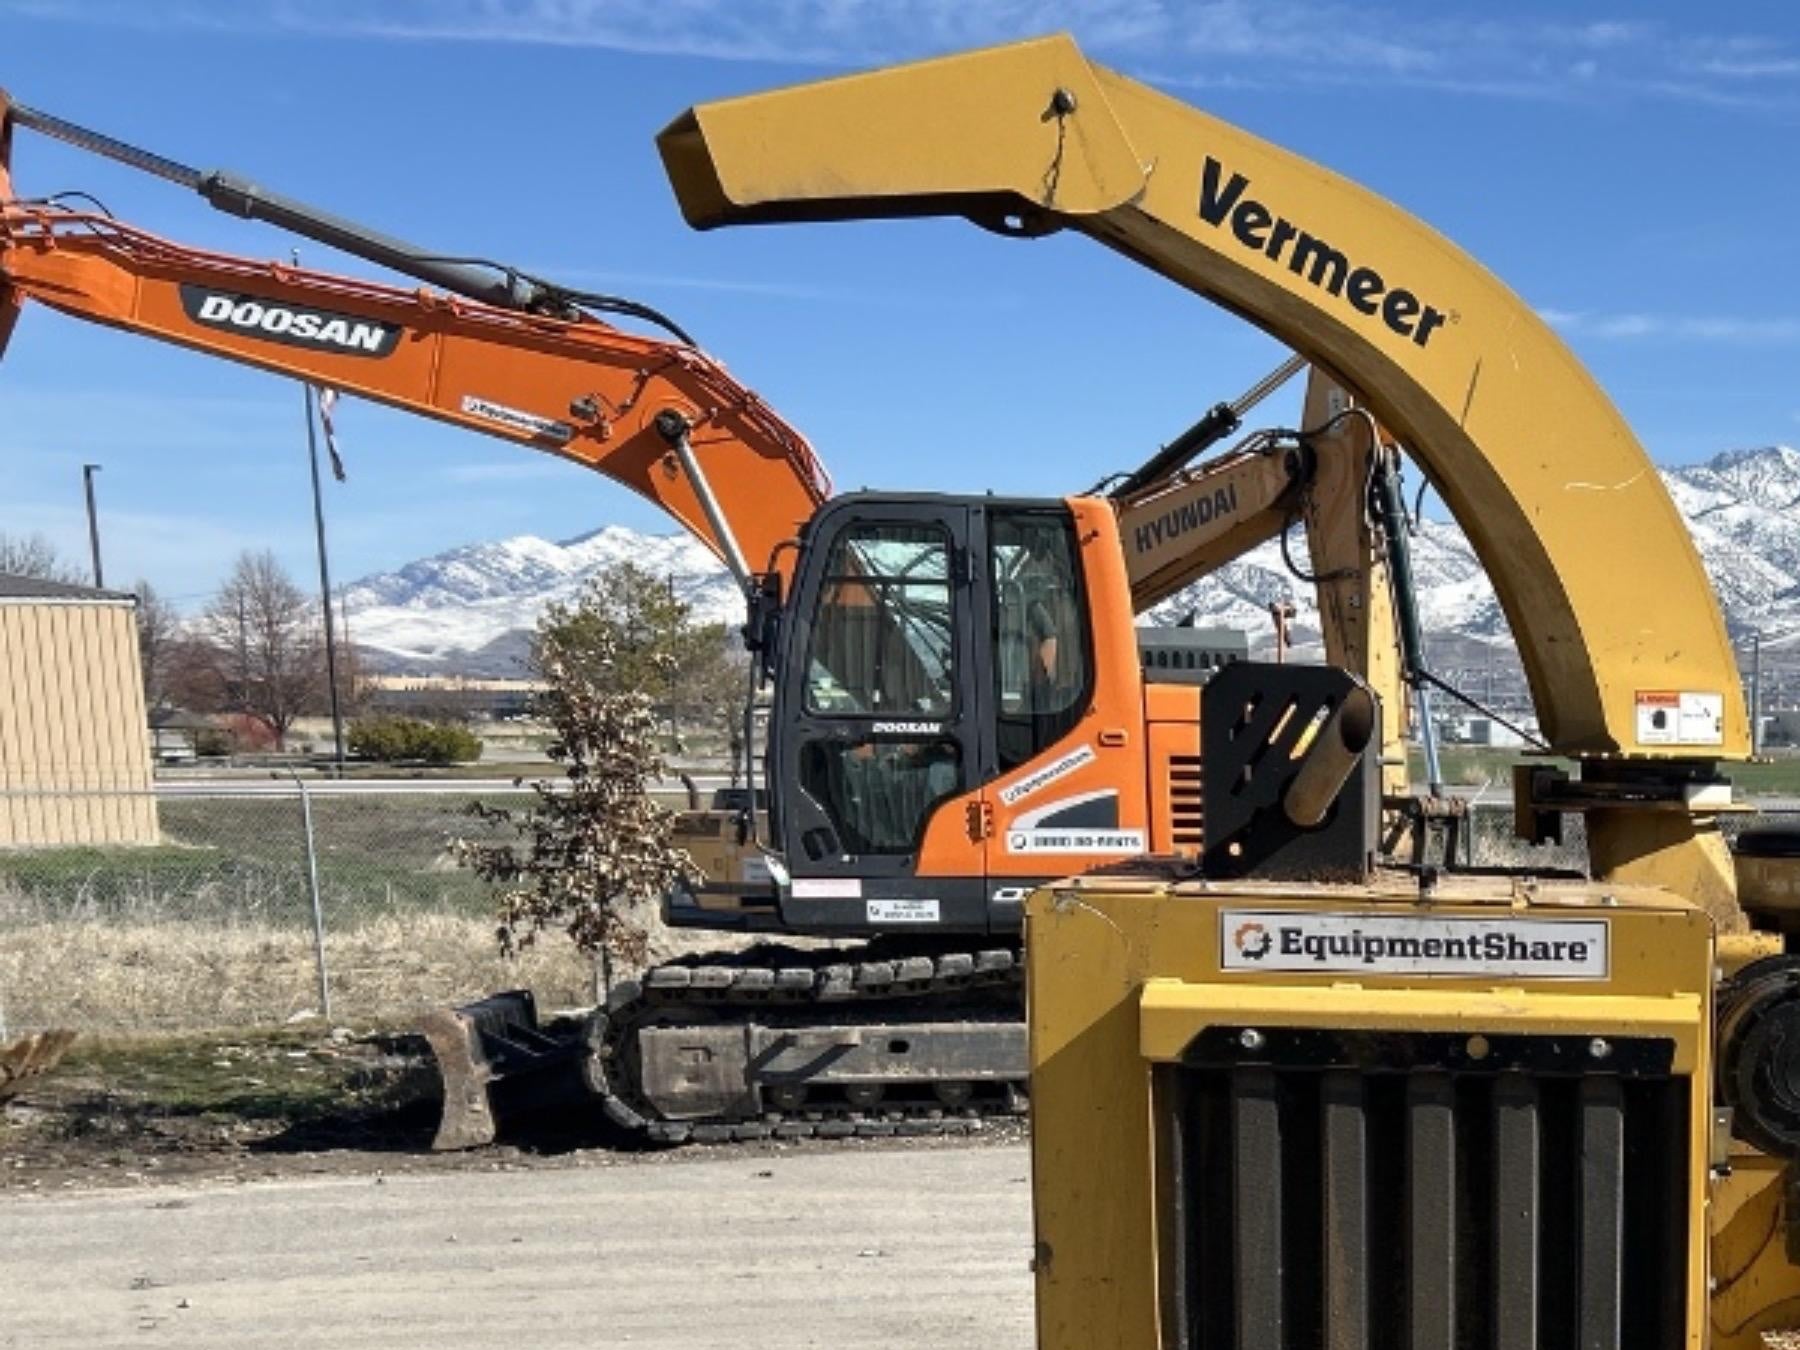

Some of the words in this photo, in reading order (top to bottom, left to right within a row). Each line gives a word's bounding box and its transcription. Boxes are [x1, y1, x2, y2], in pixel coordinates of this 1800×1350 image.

[1199, 155, 1447, 348] Vermeer
[197, 295, 386, 351] DOOSAN
[1135, 482, 1238, 554] HYUNDAI
[1279, 926, 1589, 964] EquipmentShare
